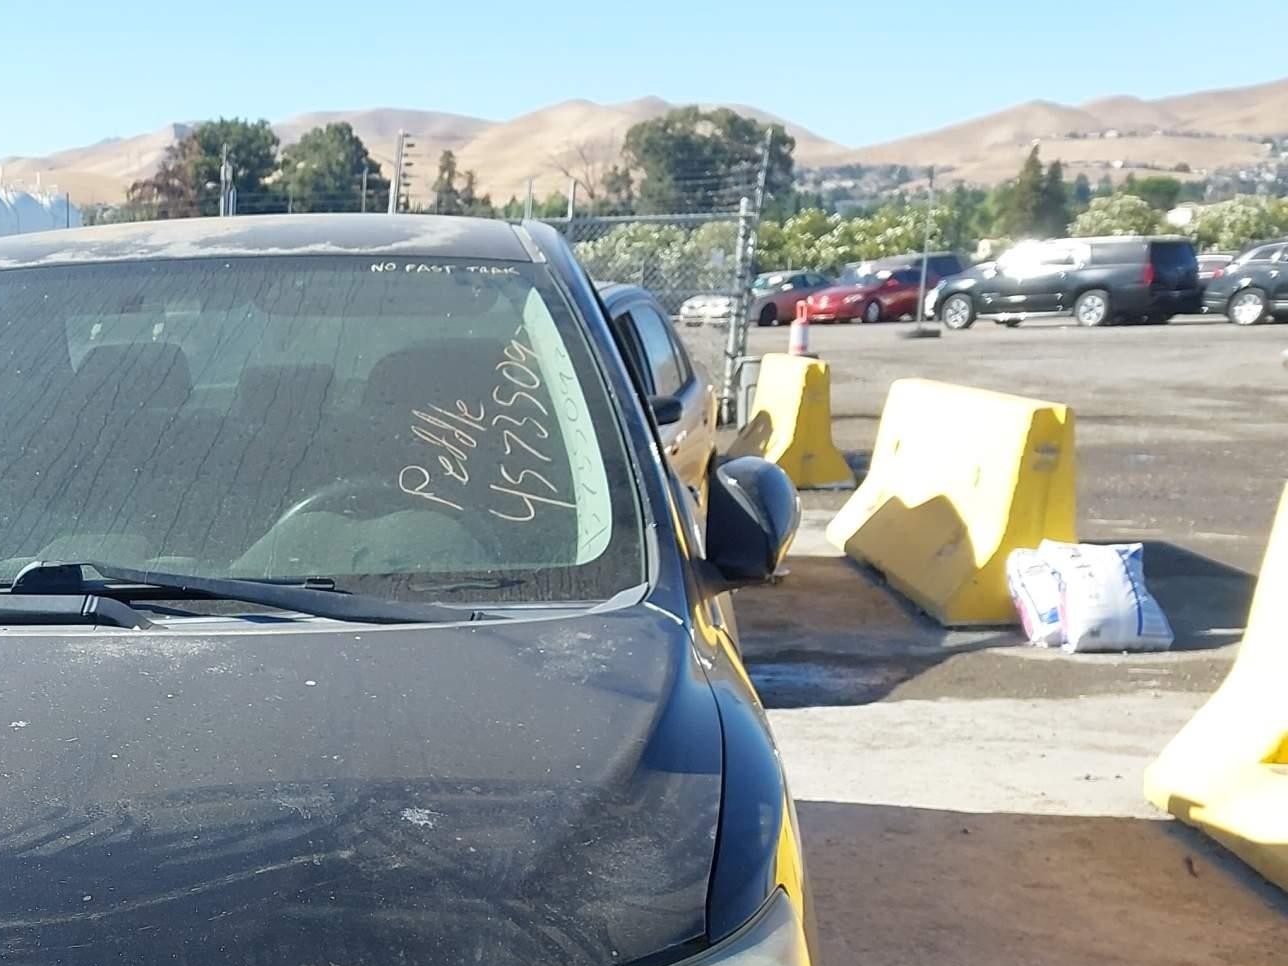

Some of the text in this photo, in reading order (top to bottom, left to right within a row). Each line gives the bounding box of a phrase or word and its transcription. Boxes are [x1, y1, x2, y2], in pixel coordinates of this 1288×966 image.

[371, 262, 396, 273] NO
[405, 263, 456, 274] FAST
[488, 325, 577, 521] 4573509
